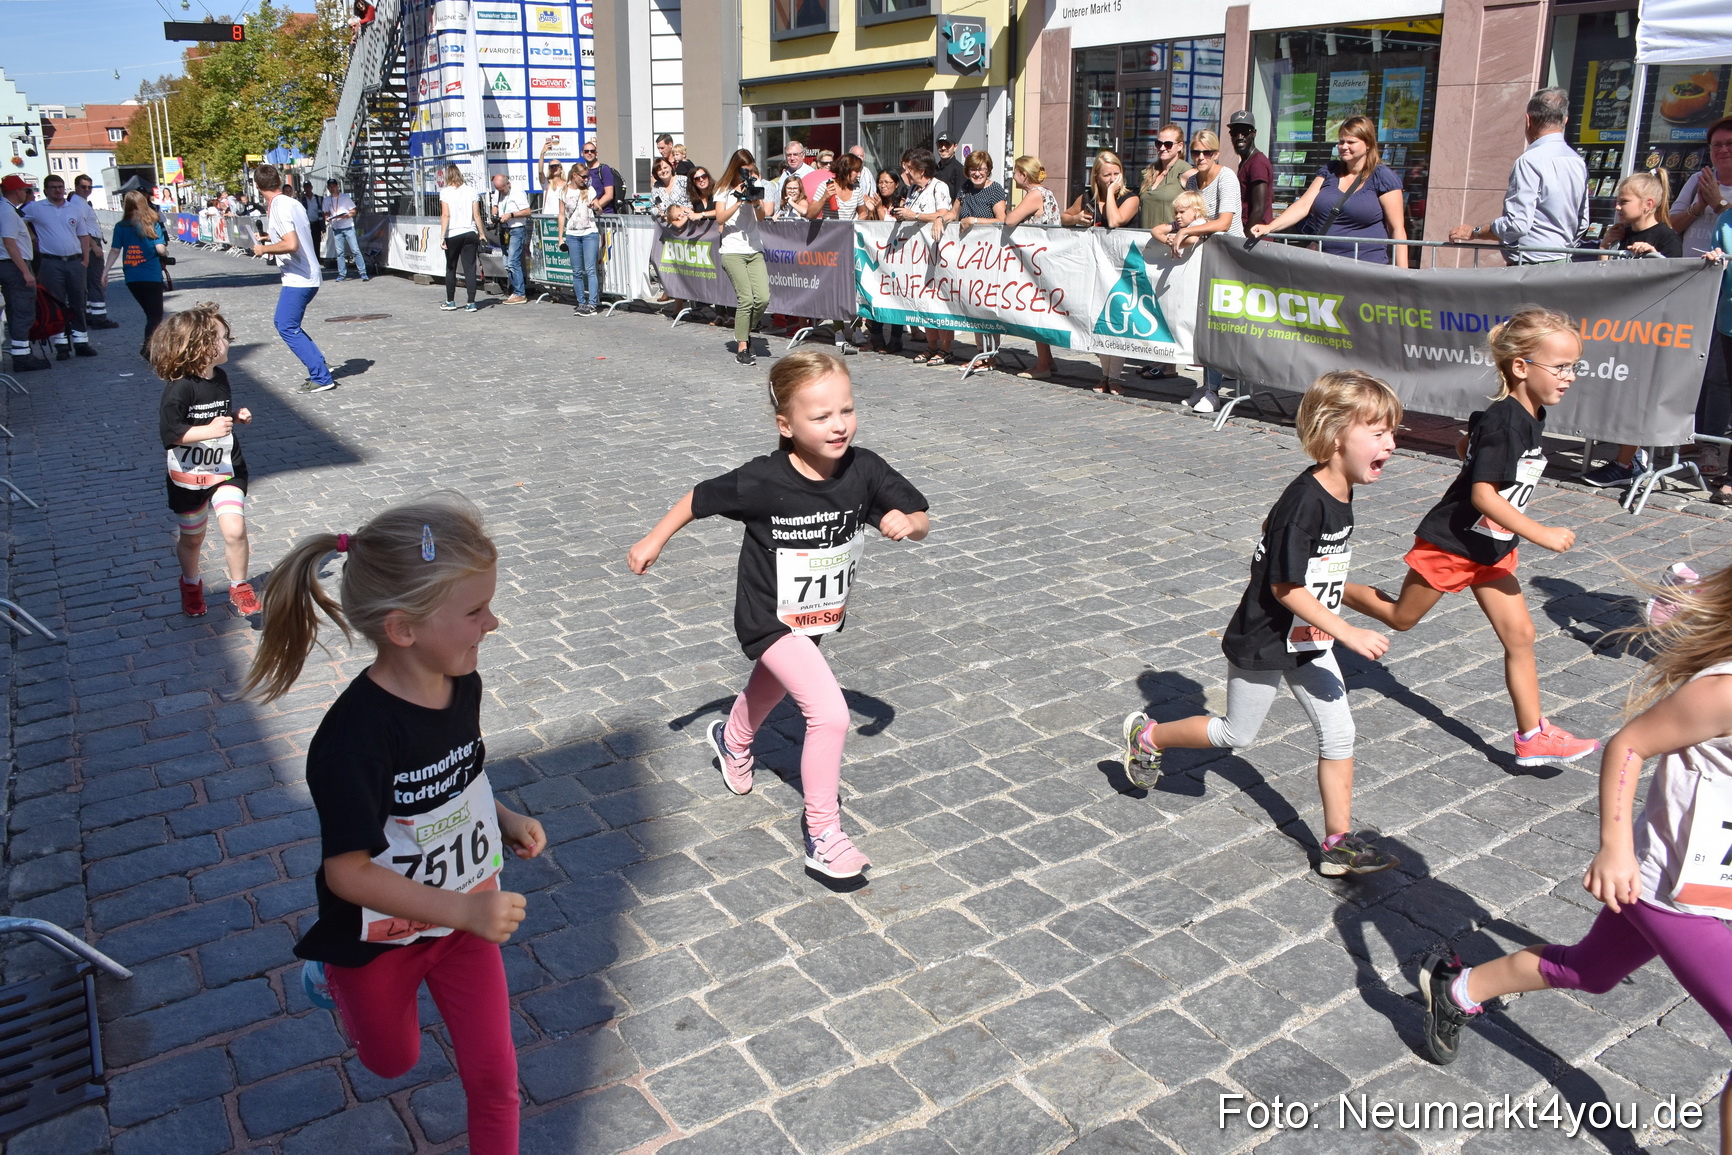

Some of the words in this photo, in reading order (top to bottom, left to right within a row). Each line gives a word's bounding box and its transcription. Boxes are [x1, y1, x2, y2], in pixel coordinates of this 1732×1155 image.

[1062, 7, 1088, 19] Unterer
[1090, 2, 1111, 15] Markt
[1113, 0, 1122, 11] 15
[232, 25, 242, 41] 8
[960, 32, 976, 56] G2
[1333, 79, 1367, 88] Radfahren
[1680, 130, 1707, 139] Rupprech
[405, 233, 419, 252] swn
[662, 240, 712, 266] BOCK
[763, 249, 797, 265] DUSTRY
[797, 250, 839, 267] LOUNGE
[911, 240, 955, 269] UNS
[768, 272, 820, 290] ockonline.de
[1210, 282, 1343, 330] BOCK
[1207, 318, 1247, 335] inspired
[1250, 324, 1265, 339] by
[1267, 328, 1301, 342] smart
[1303, 333, 1354, 350] concepts
[1359, 302, 1434, 330] OFFICE
[1439, 310, 1512, 334] INDU
[1580, 317, 1694, 349] LOUNGE
[1131, 343, 1153, 355] Service
[1153, 346, 1176, 357] GmbH
[179, 445, 224, 466] 7000
[770, 511, 840, 527] Neumarkter
[772, 525, 828, 541] Stadtlauf
[808, 549, 852, 569] BOCK
[794, 559, 857, 604] 7116
[800, 603, 822, 611] PARTL
[393, 766, 461, 805] tadtlauf
[417, 801, 471, 842] BOCK
[391, 819, 490, 889] 7516
[1693, 853, 1707, 863] B1
[454, 876, 476, 893] markt
